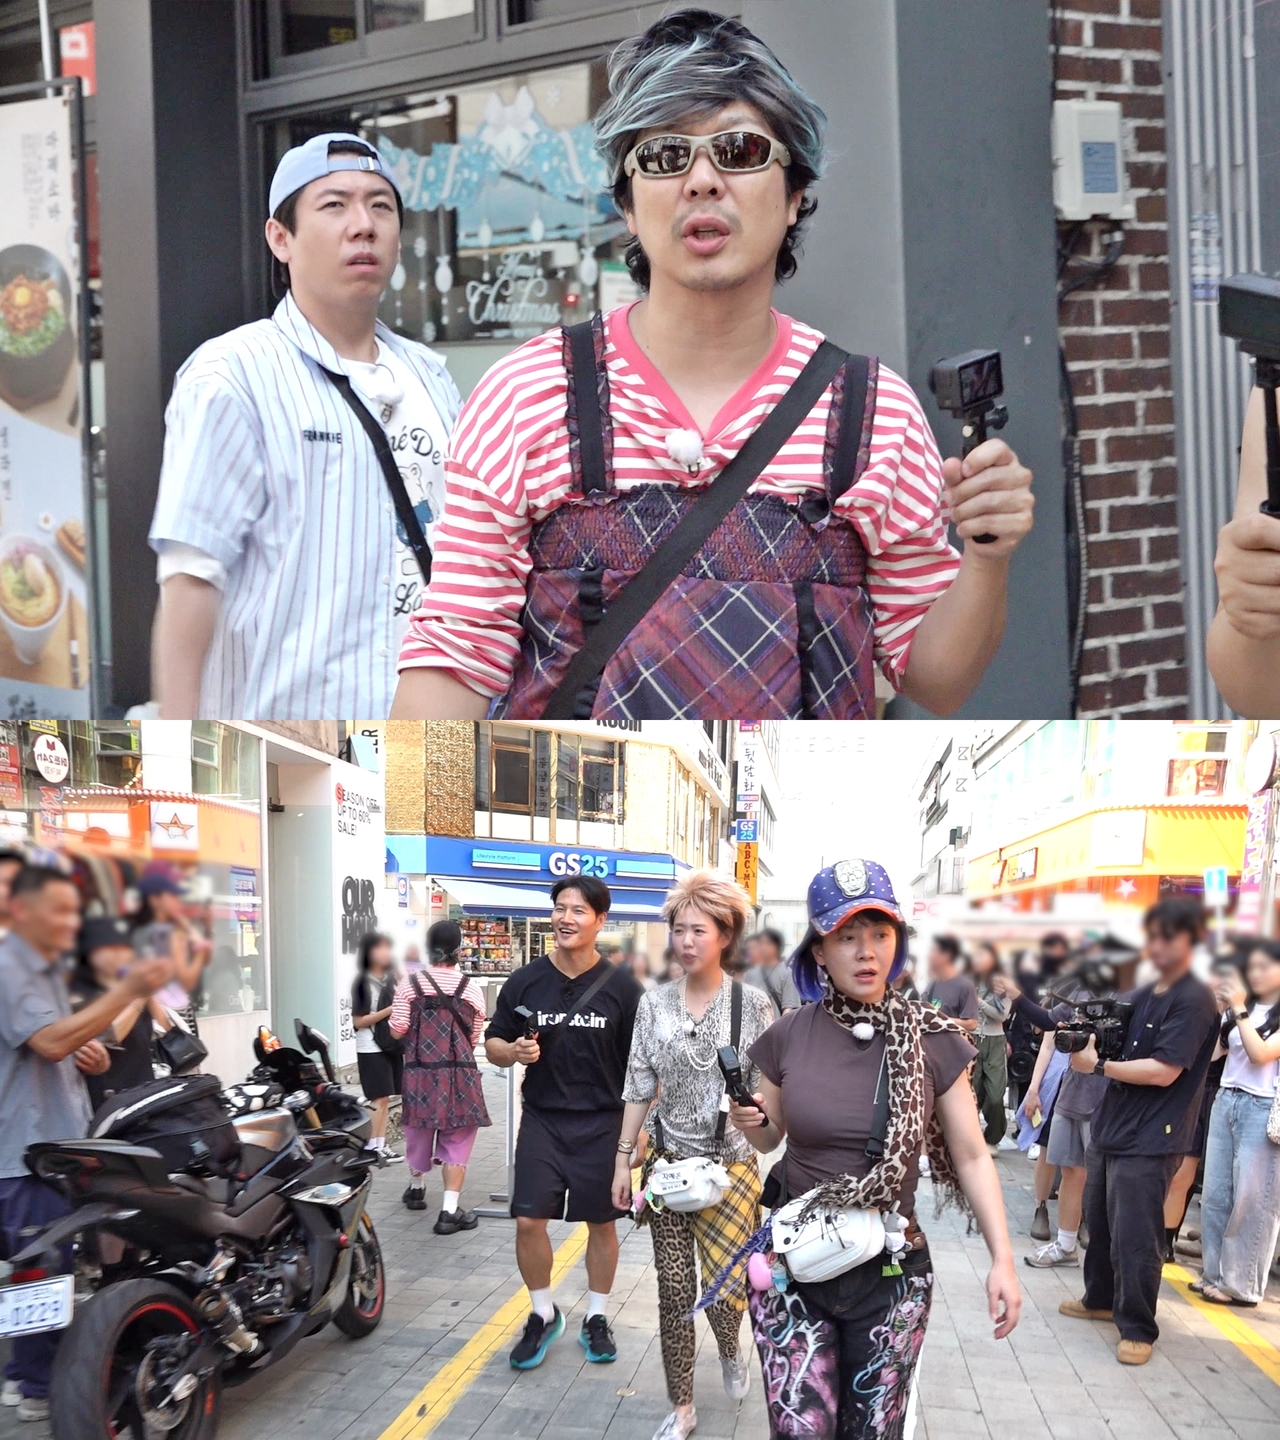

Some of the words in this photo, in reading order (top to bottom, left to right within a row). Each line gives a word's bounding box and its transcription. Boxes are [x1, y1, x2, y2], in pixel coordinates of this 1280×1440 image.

[465, 276, 562, 325] Christmas
[303, 429, 342, 444] FRANKIE
[744, 748, 755, 792] 뒷담화
[336, 786, 364, 807] SEASON
[337, 805, 346, 817] UP
[348, 806, 357, 821] TO
[740, 821, 754, 830] GS
[740, 831, 754, 840] 25
[548, 852, 609, 878] GS25
[342, 876, 375, 916] OUR
[340, 1014, 349, 1026] UP
